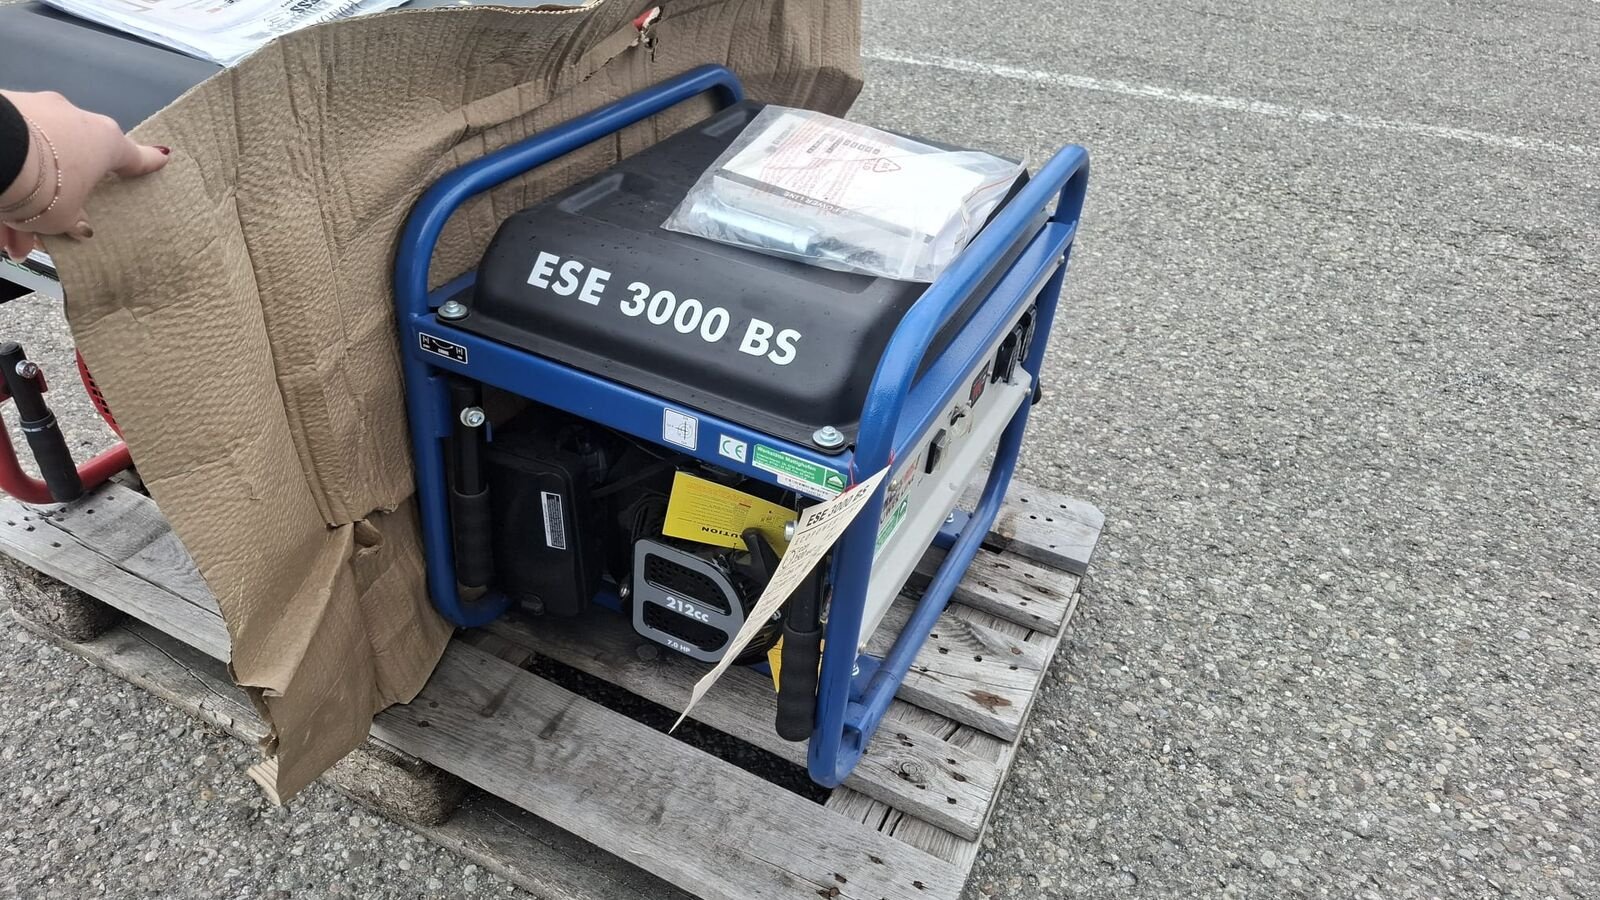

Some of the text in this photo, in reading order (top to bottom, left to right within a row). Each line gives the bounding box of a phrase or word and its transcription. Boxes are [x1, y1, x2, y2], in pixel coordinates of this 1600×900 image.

[527, 251, 802, 366] ESE 3000 BS
[722, 440, 744, 459] CE
[806, 509, 829, 528] ESE
[666, 596, 709, 622] 212cc
[680, 644, 691, 652] HP
